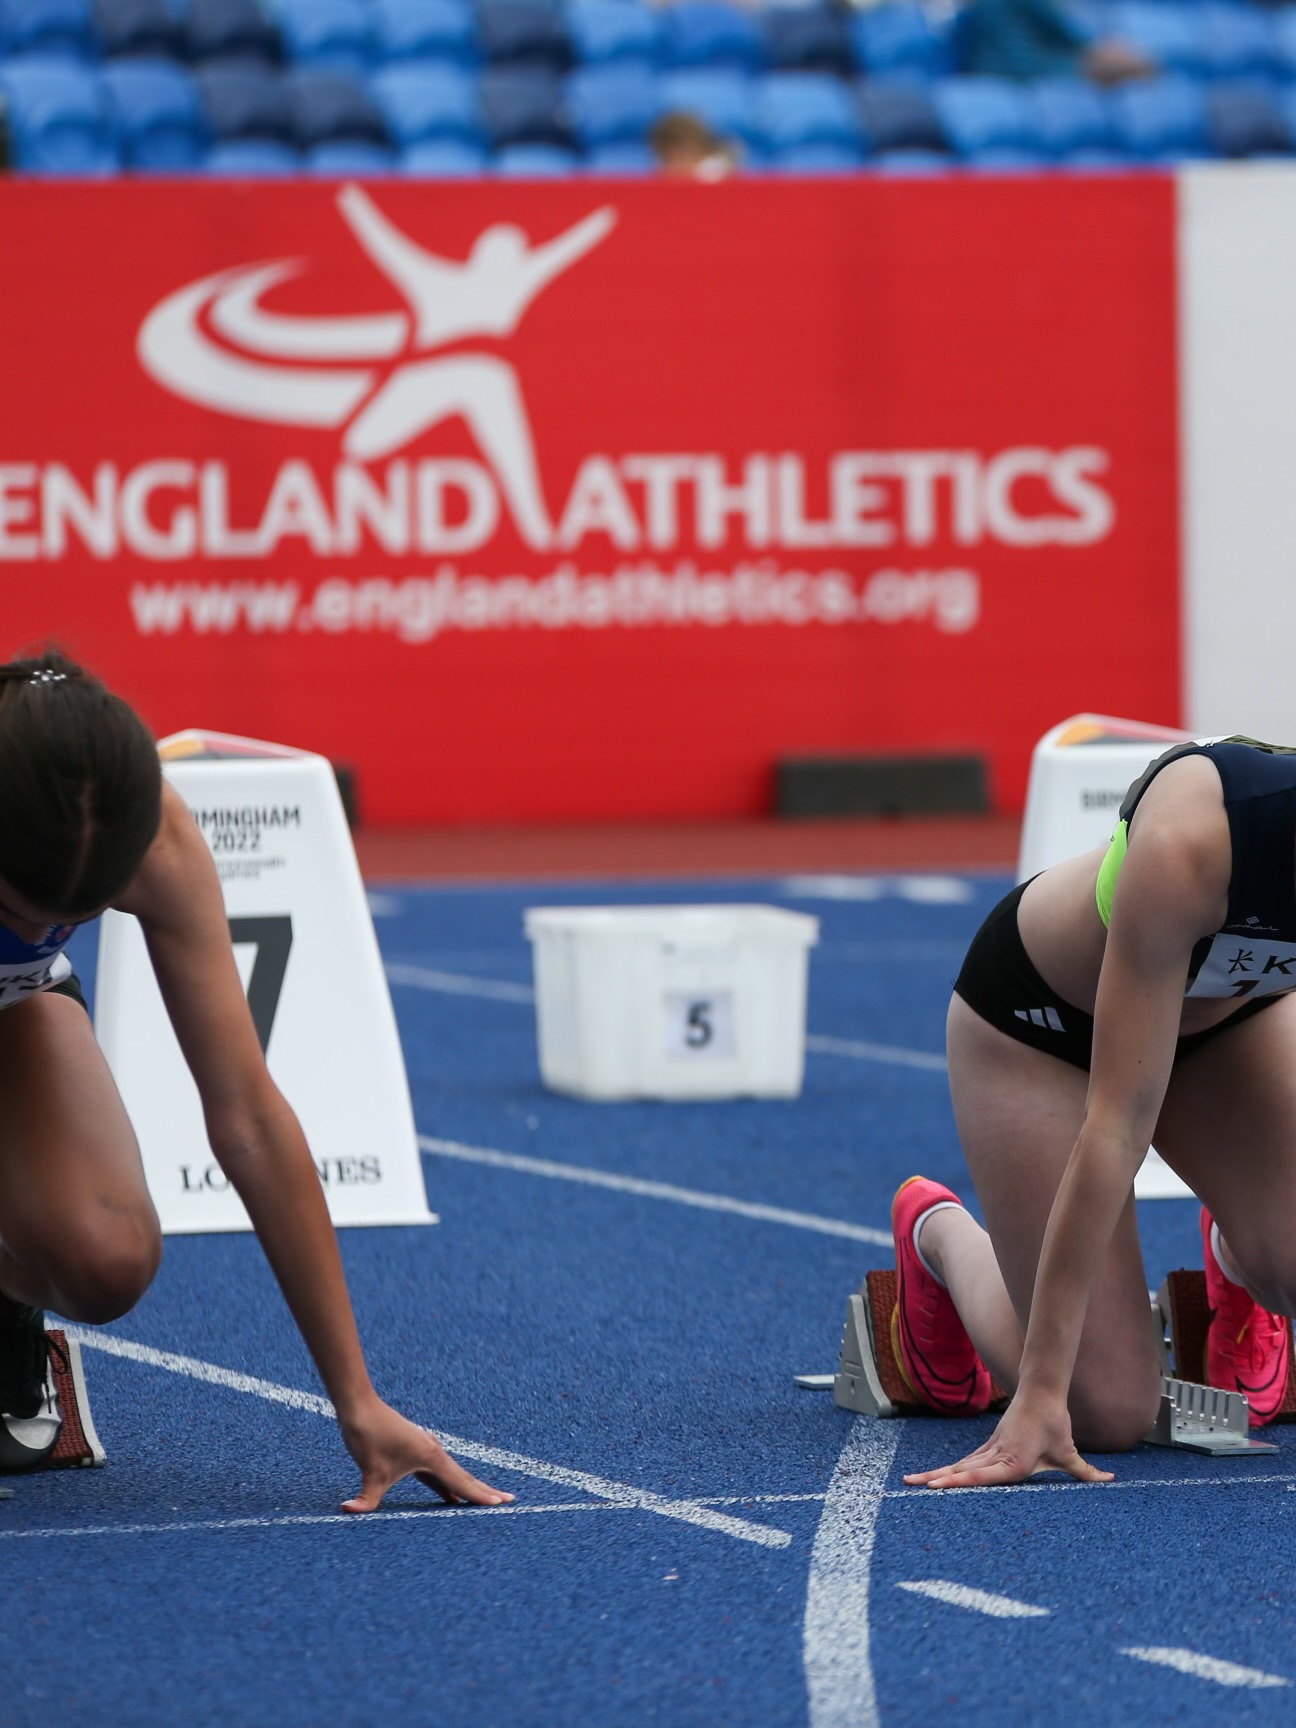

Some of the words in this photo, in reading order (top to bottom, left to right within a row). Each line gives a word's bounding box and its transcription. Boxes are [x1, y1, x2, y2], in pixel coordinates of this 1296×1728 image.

[0, 457, 500, 560] ENGLAND
[556, 446, 1115, 552] ATHLETICS
[131, 561, 980, 641] www.englandathletics.org
[212, 828, 261, 852] 2022
[225, 913, 294, 1065] 7
[684, 1000, 713, 1050] 5
